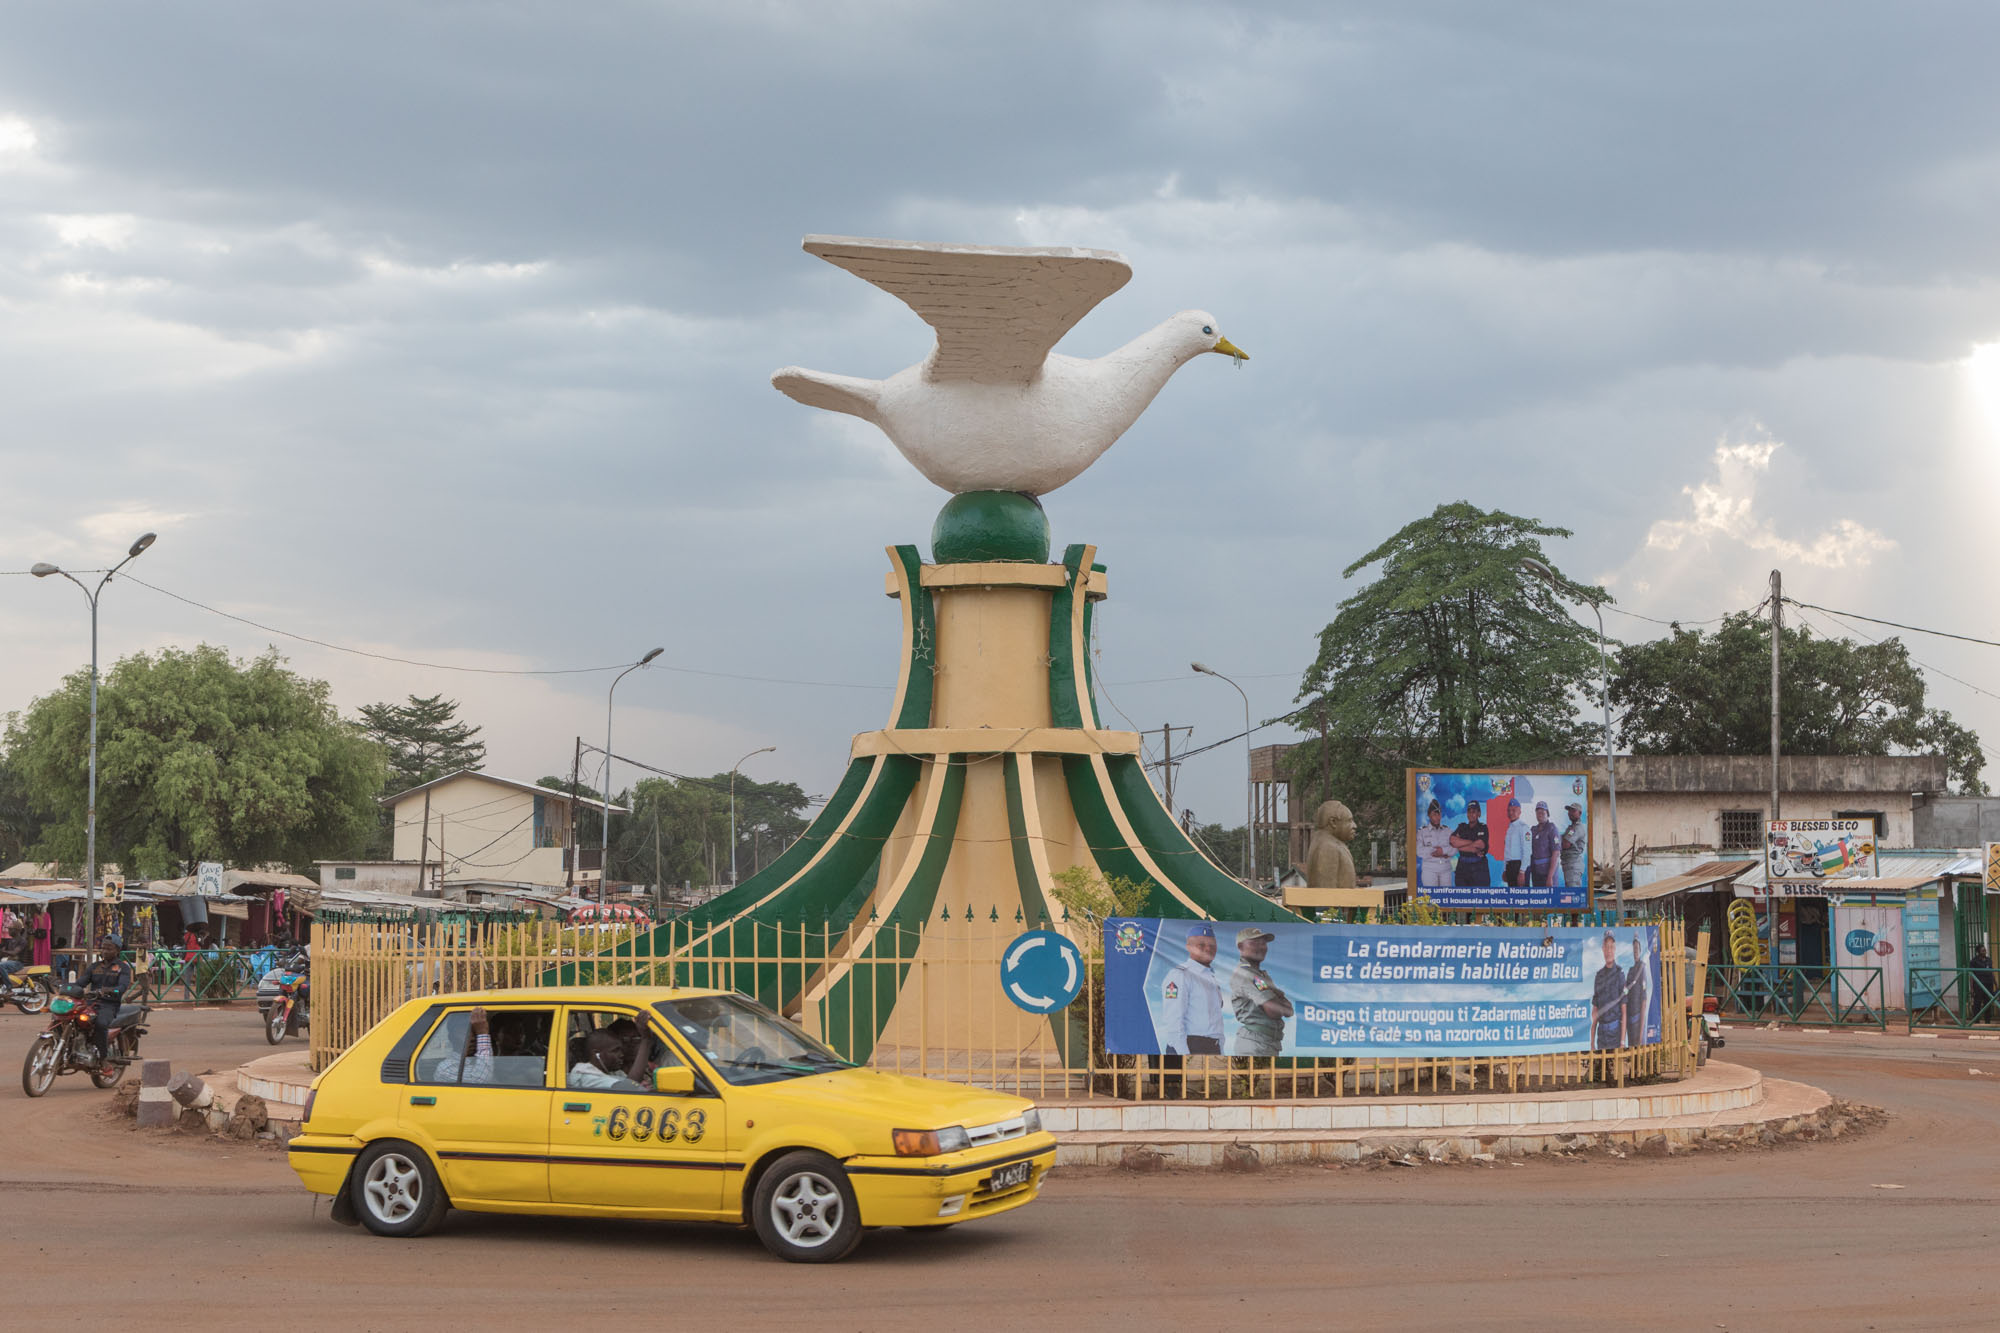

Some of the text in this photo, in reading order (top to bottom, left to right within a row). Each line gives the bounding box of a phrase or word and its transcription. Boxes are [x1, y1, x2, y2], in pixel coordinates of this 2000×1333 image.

[1771, 822, 1788, 831] ETS
[1790, 822, 1829, 831] BLESSED
[1347, 940, 1564, 959] La Gendarmerie Nationale
[1320, 962, 1579, 980] est désormais habillée en Bleu
[1359, 1006, 1370, 1022] ti
[1373, 1007, 1454, 1025] atourougou
[1458, 1006, 1469, 1022] ti
[1471, 1005, 1536, 1022] Zadarmalé
[1538, 1006, 1546, 1020] ti
[1549, 1004, 1587, 1020] Beafrica
[1321, 1026, 1365, 1045] ayeké
[1404, 1030, 1422, 1042] so
[1425, 1030, 1442, 1042] na
[1445, 1027, 1500, 1042] nzoroko
[1504, 1026, 1514, 1041] ti
[1517, 1025, 1530, 1041] Lé
[1532, 1025, 1573, 1040] ndouzou
